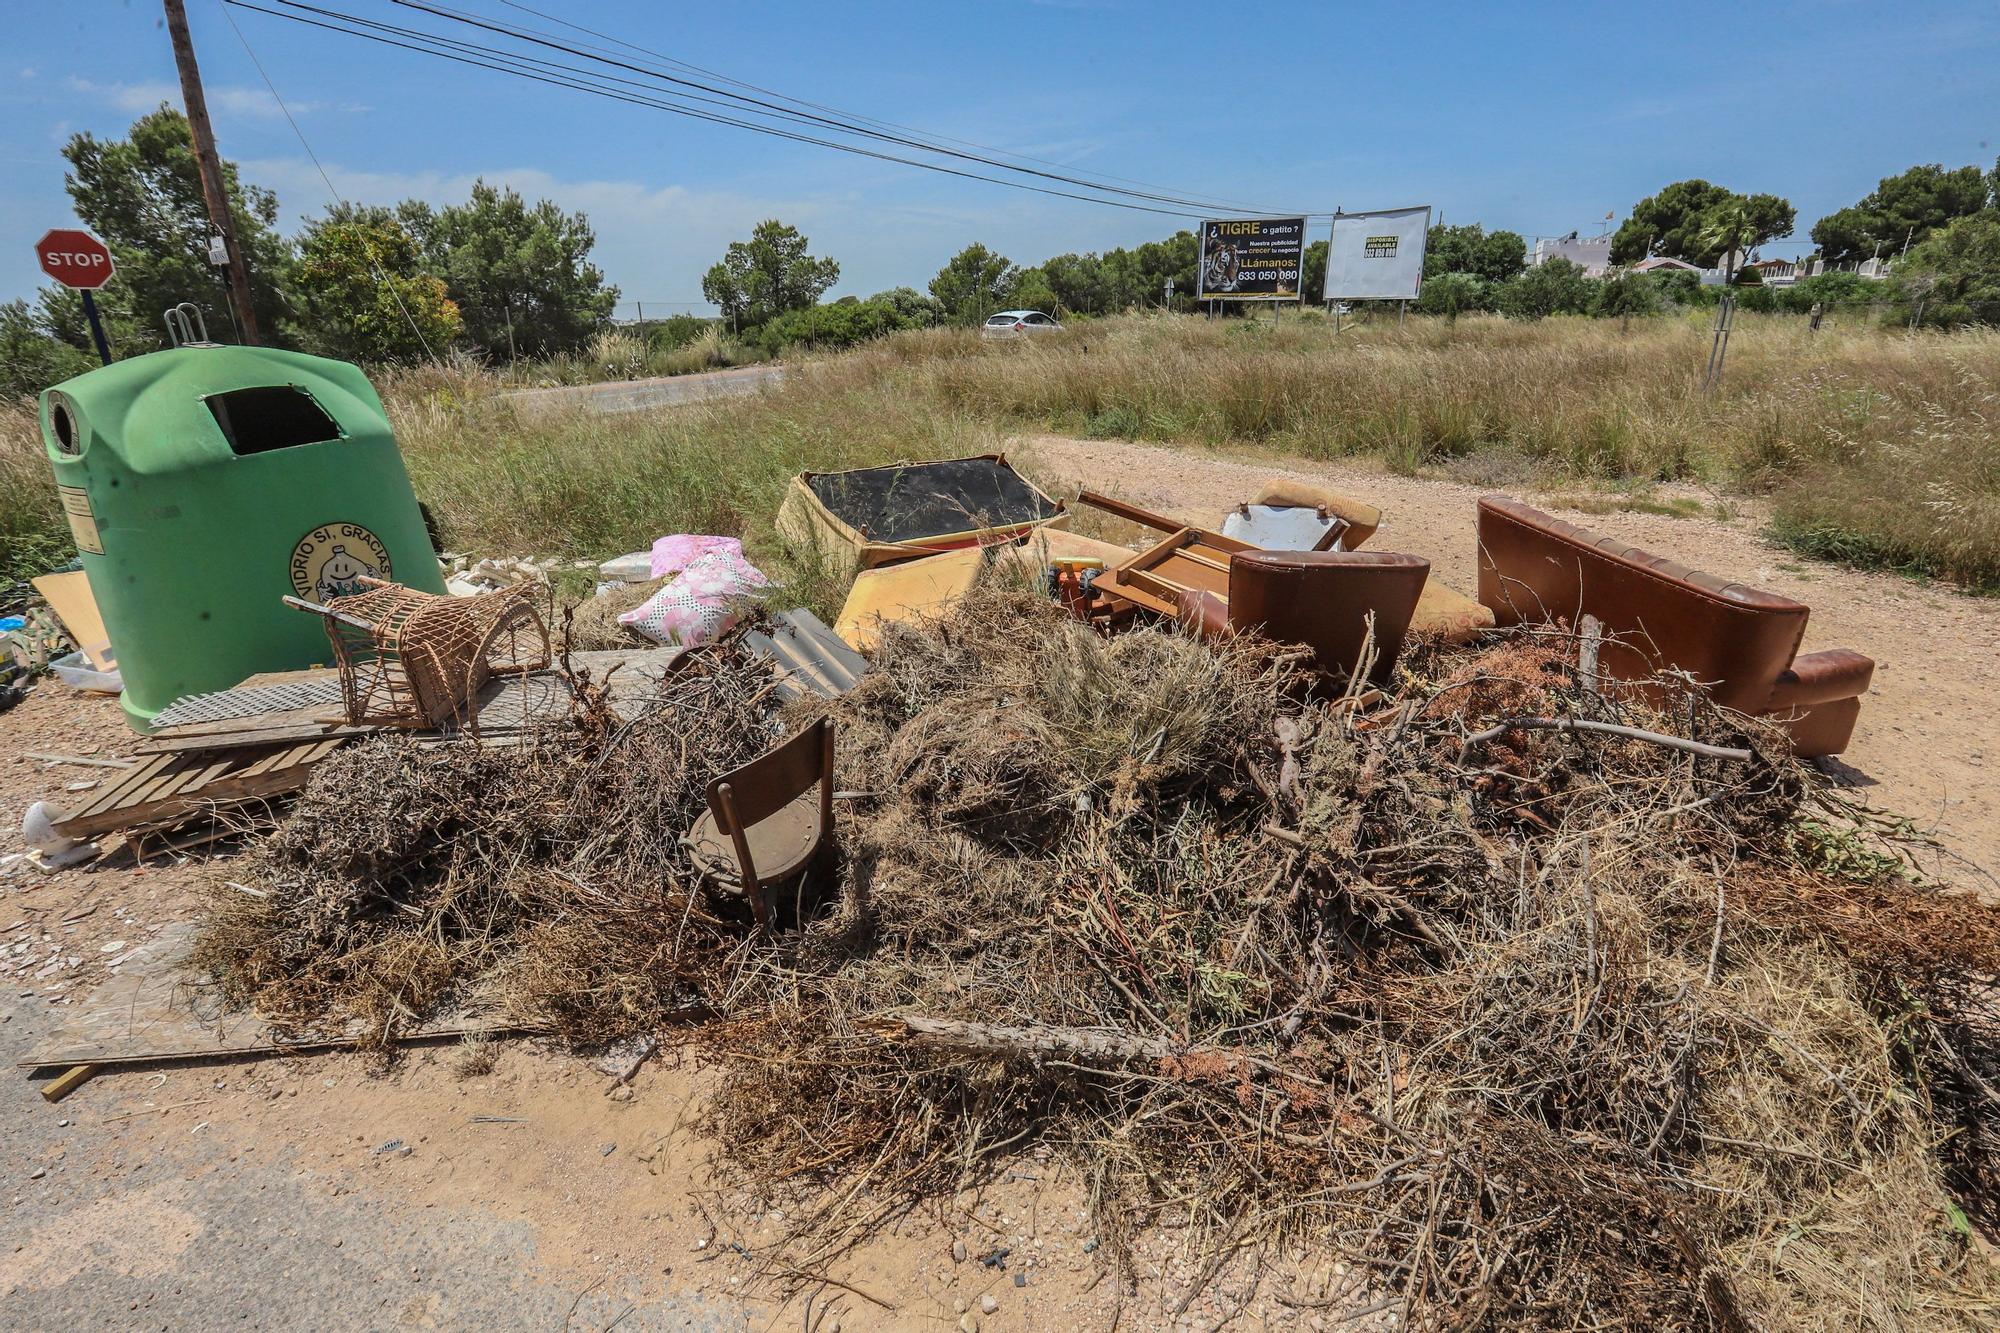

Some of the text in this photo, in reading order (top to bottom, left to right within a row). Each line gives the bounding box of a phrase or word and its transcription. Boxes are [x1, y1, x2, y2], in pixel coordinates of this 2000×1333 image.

[1269, 226, 1292, 236] gatito
[47, 252, 104, 267] STOP
[1241, 259, 1297, 268] LLámanos:
[1238, 271, 1298, 280] 633 050 080
[293, 542, 314, 596] VIDRIO
[341, 525, 390, 574] GRACIAS
